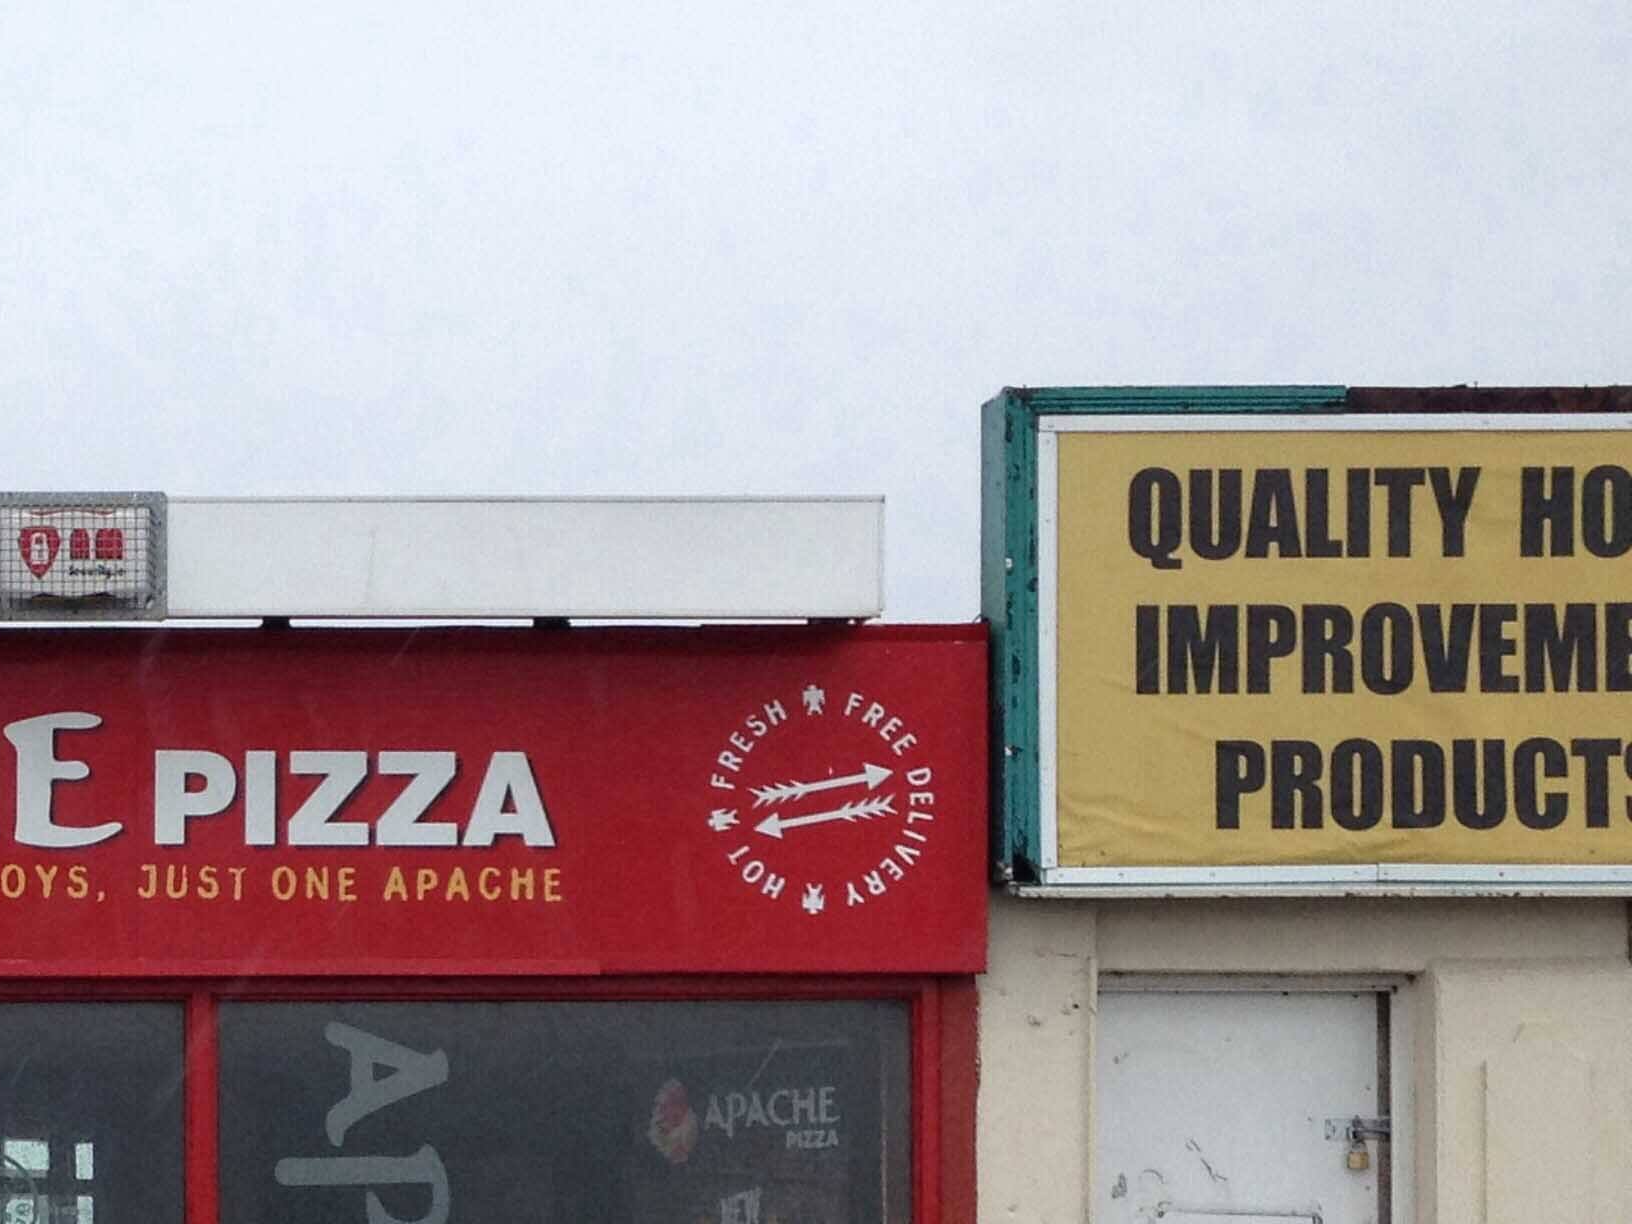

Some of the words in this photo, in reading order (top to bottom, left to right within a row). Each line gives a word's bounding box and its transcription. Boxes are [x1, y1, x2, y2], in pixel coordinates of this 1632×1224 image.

[1128, 466, 1482, 569] QUALITY
[1520, 465, 1632, 558] HO
[710, 699, 788, 790] FRESH
[843, 692, 917, 756] FREE
[154, 750, 556, 847] PIZZA
[1215, 737, 1632, 830] PRODUCT
[727, 845, 786, 899] HOT
[846, 766, 934, 907] DELIVERY
[137, 863, 246, 901] JUST
[271, 866, 358, 901] ONE
[384, 866, 563, 902] APACHE
[702, 1086, 841, 1139] APACHE
[785, 1129, 840, 1149] PIZZA
